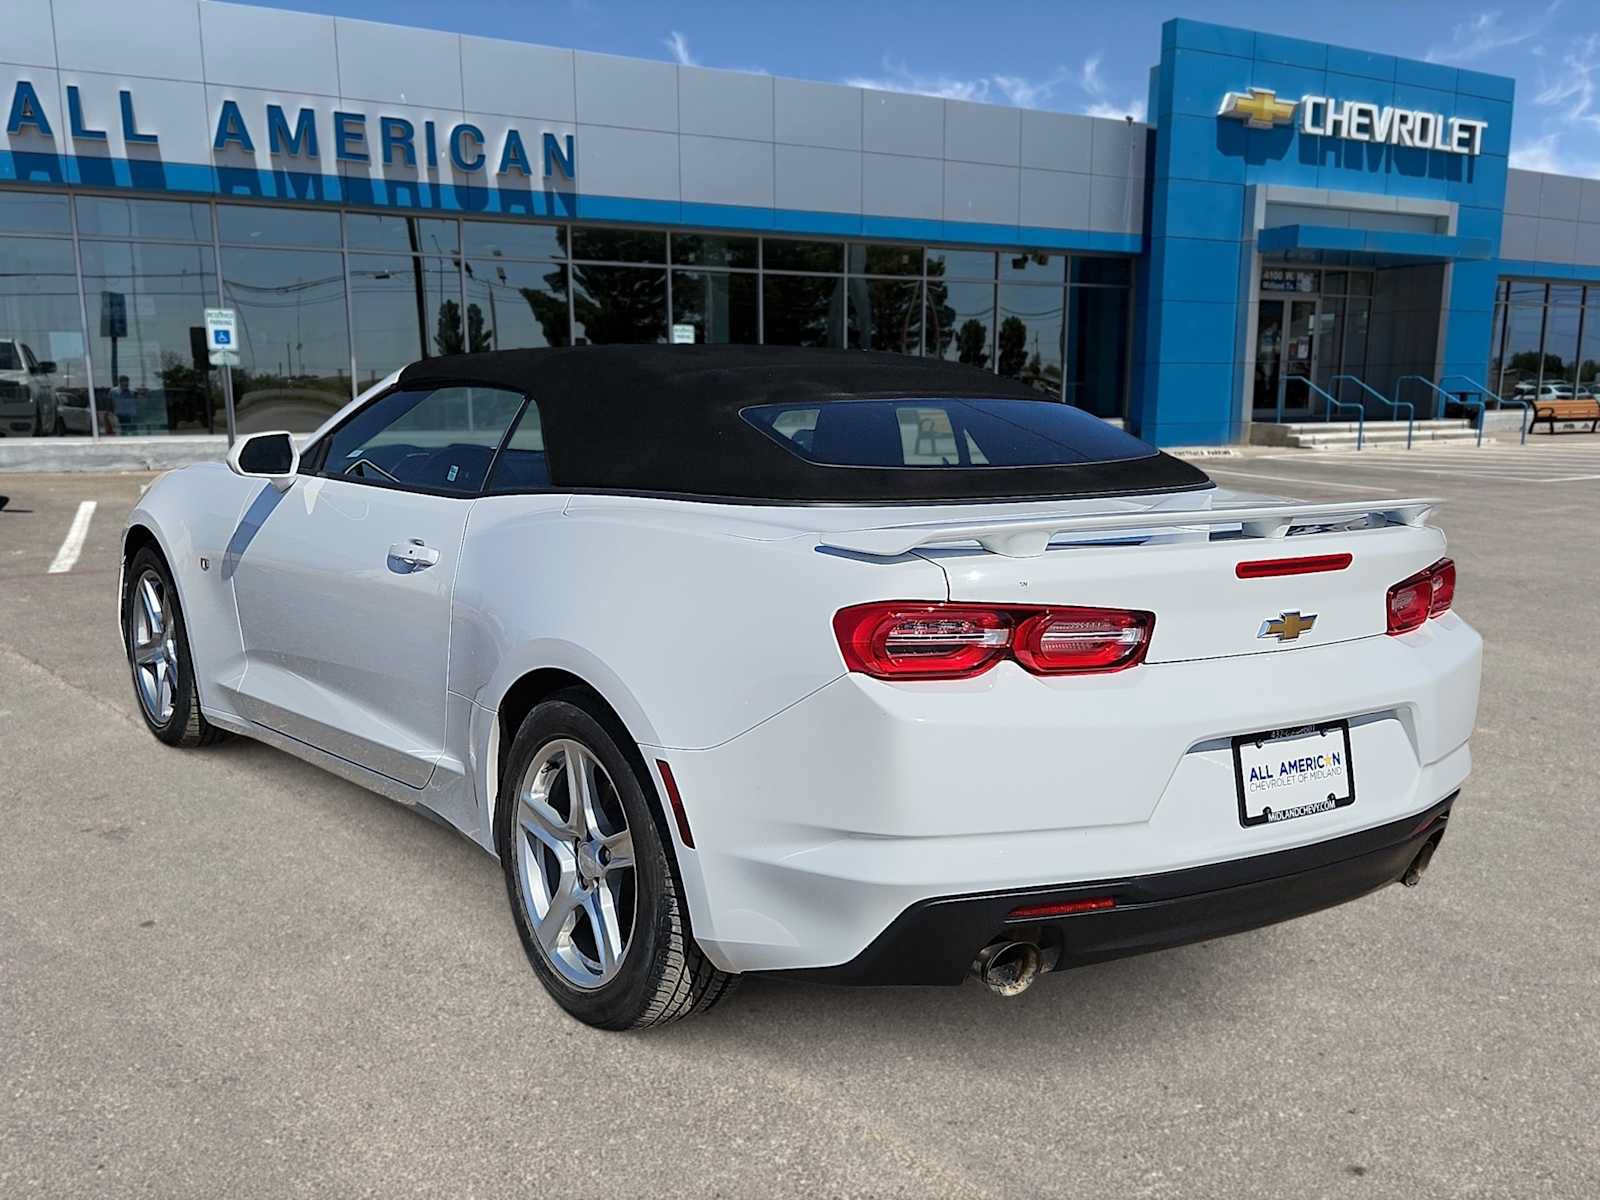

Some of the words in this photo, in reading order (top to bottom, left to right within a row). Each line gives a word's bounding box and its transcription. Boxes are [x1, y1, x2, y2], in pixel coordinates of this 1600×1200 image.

[6, 80, 159, 144] ALL
[213, 99, 576, 179] AMERICAN
[1301, 94, 1488, 156] CHEVROLET
[1249, 764, 1274, 782] ALL
[1249, 775, 1296, 793] CHEVROLET
[1297, 774, 1308, 784] OF
[1309, 767, 1343, 781] MIDLAND
[1267, 799, 1336, 823] MIDLANDCHEVY.COM
